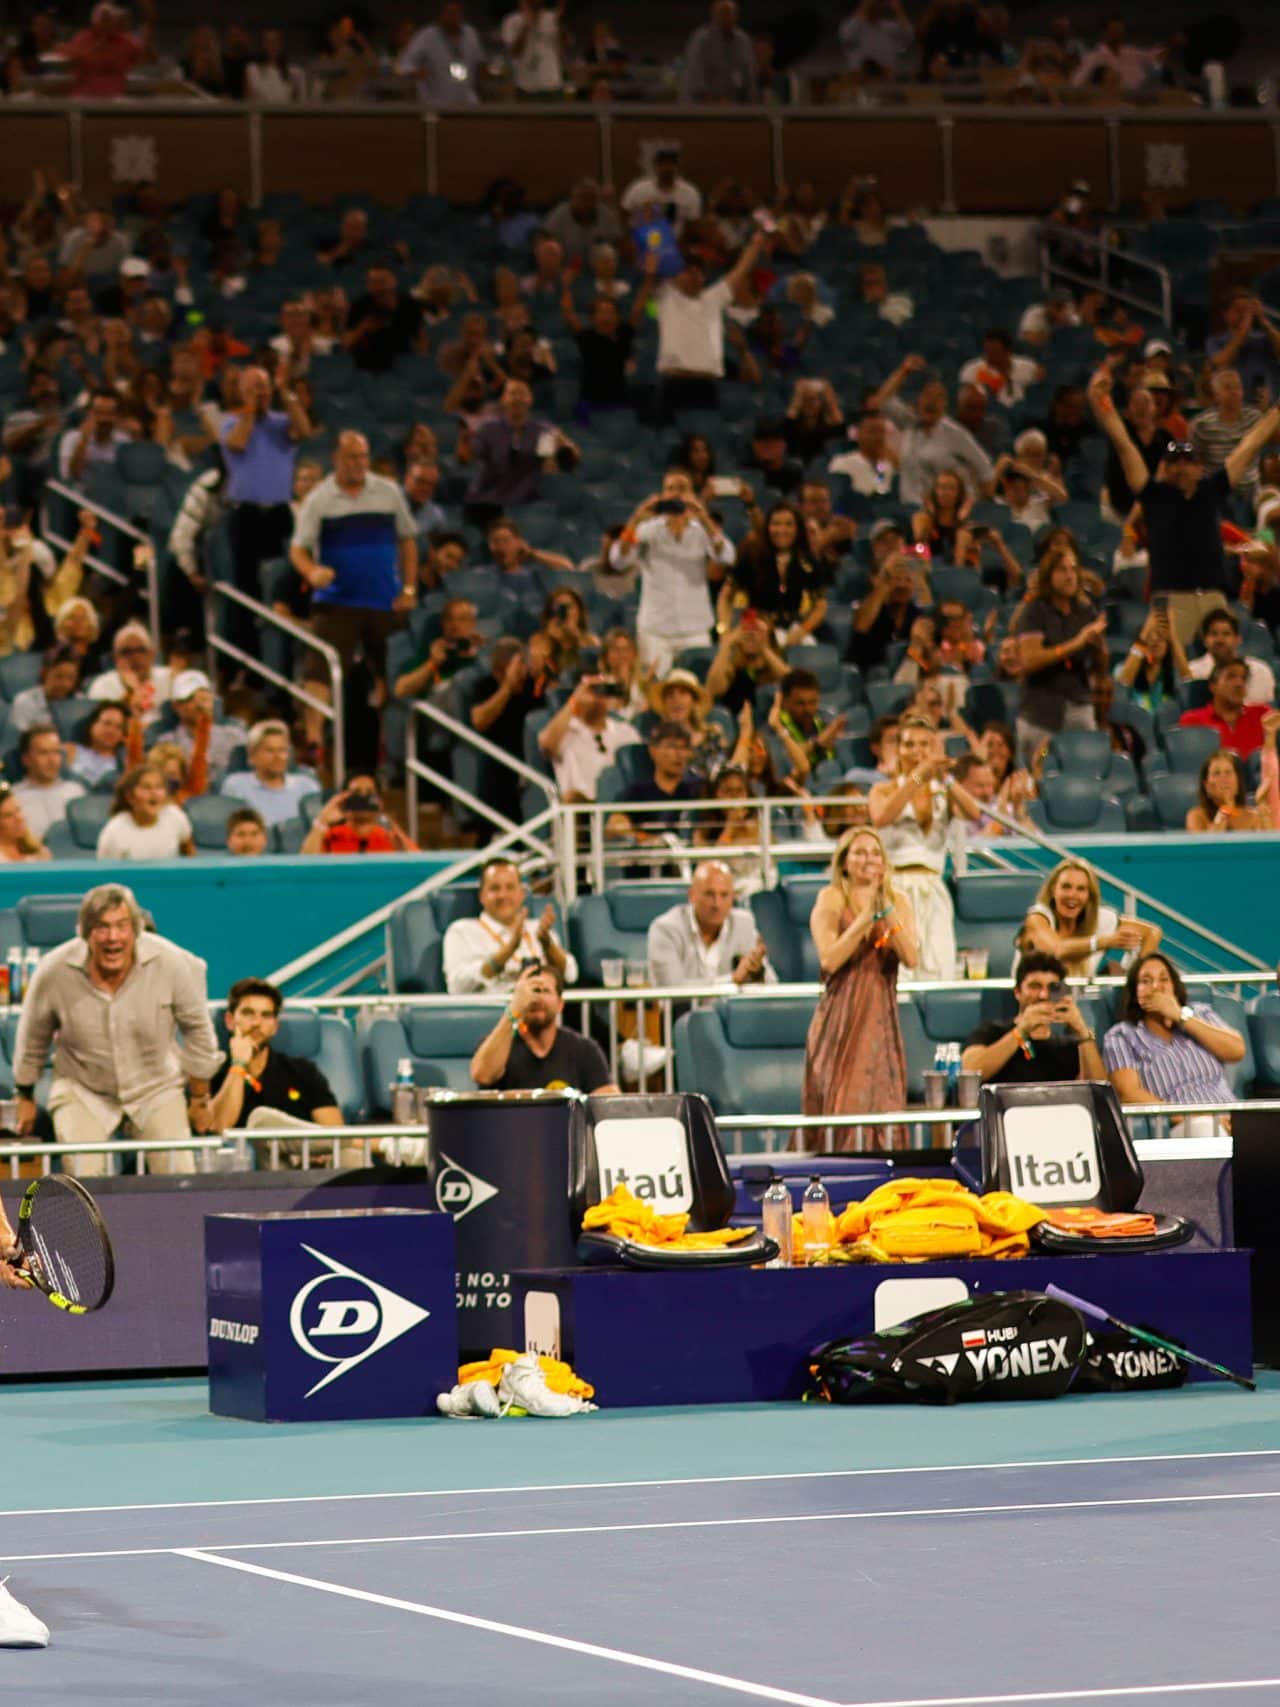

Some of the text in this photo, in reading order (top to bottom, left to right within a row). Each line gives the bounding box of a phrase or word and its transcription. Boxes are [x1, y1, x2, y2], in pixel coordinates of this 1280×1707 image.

[1014, 1152, 1092, 1187] Itaú
[466, 1272, 511, 1288] NO.1
[485, 1292, 512, 1308] TO
[209, 1318, 260, 1345] DUNLOP
[966, 1336, 1071, 1382] YONEX
[1107, 1347, 1181, 1379] YONEX
